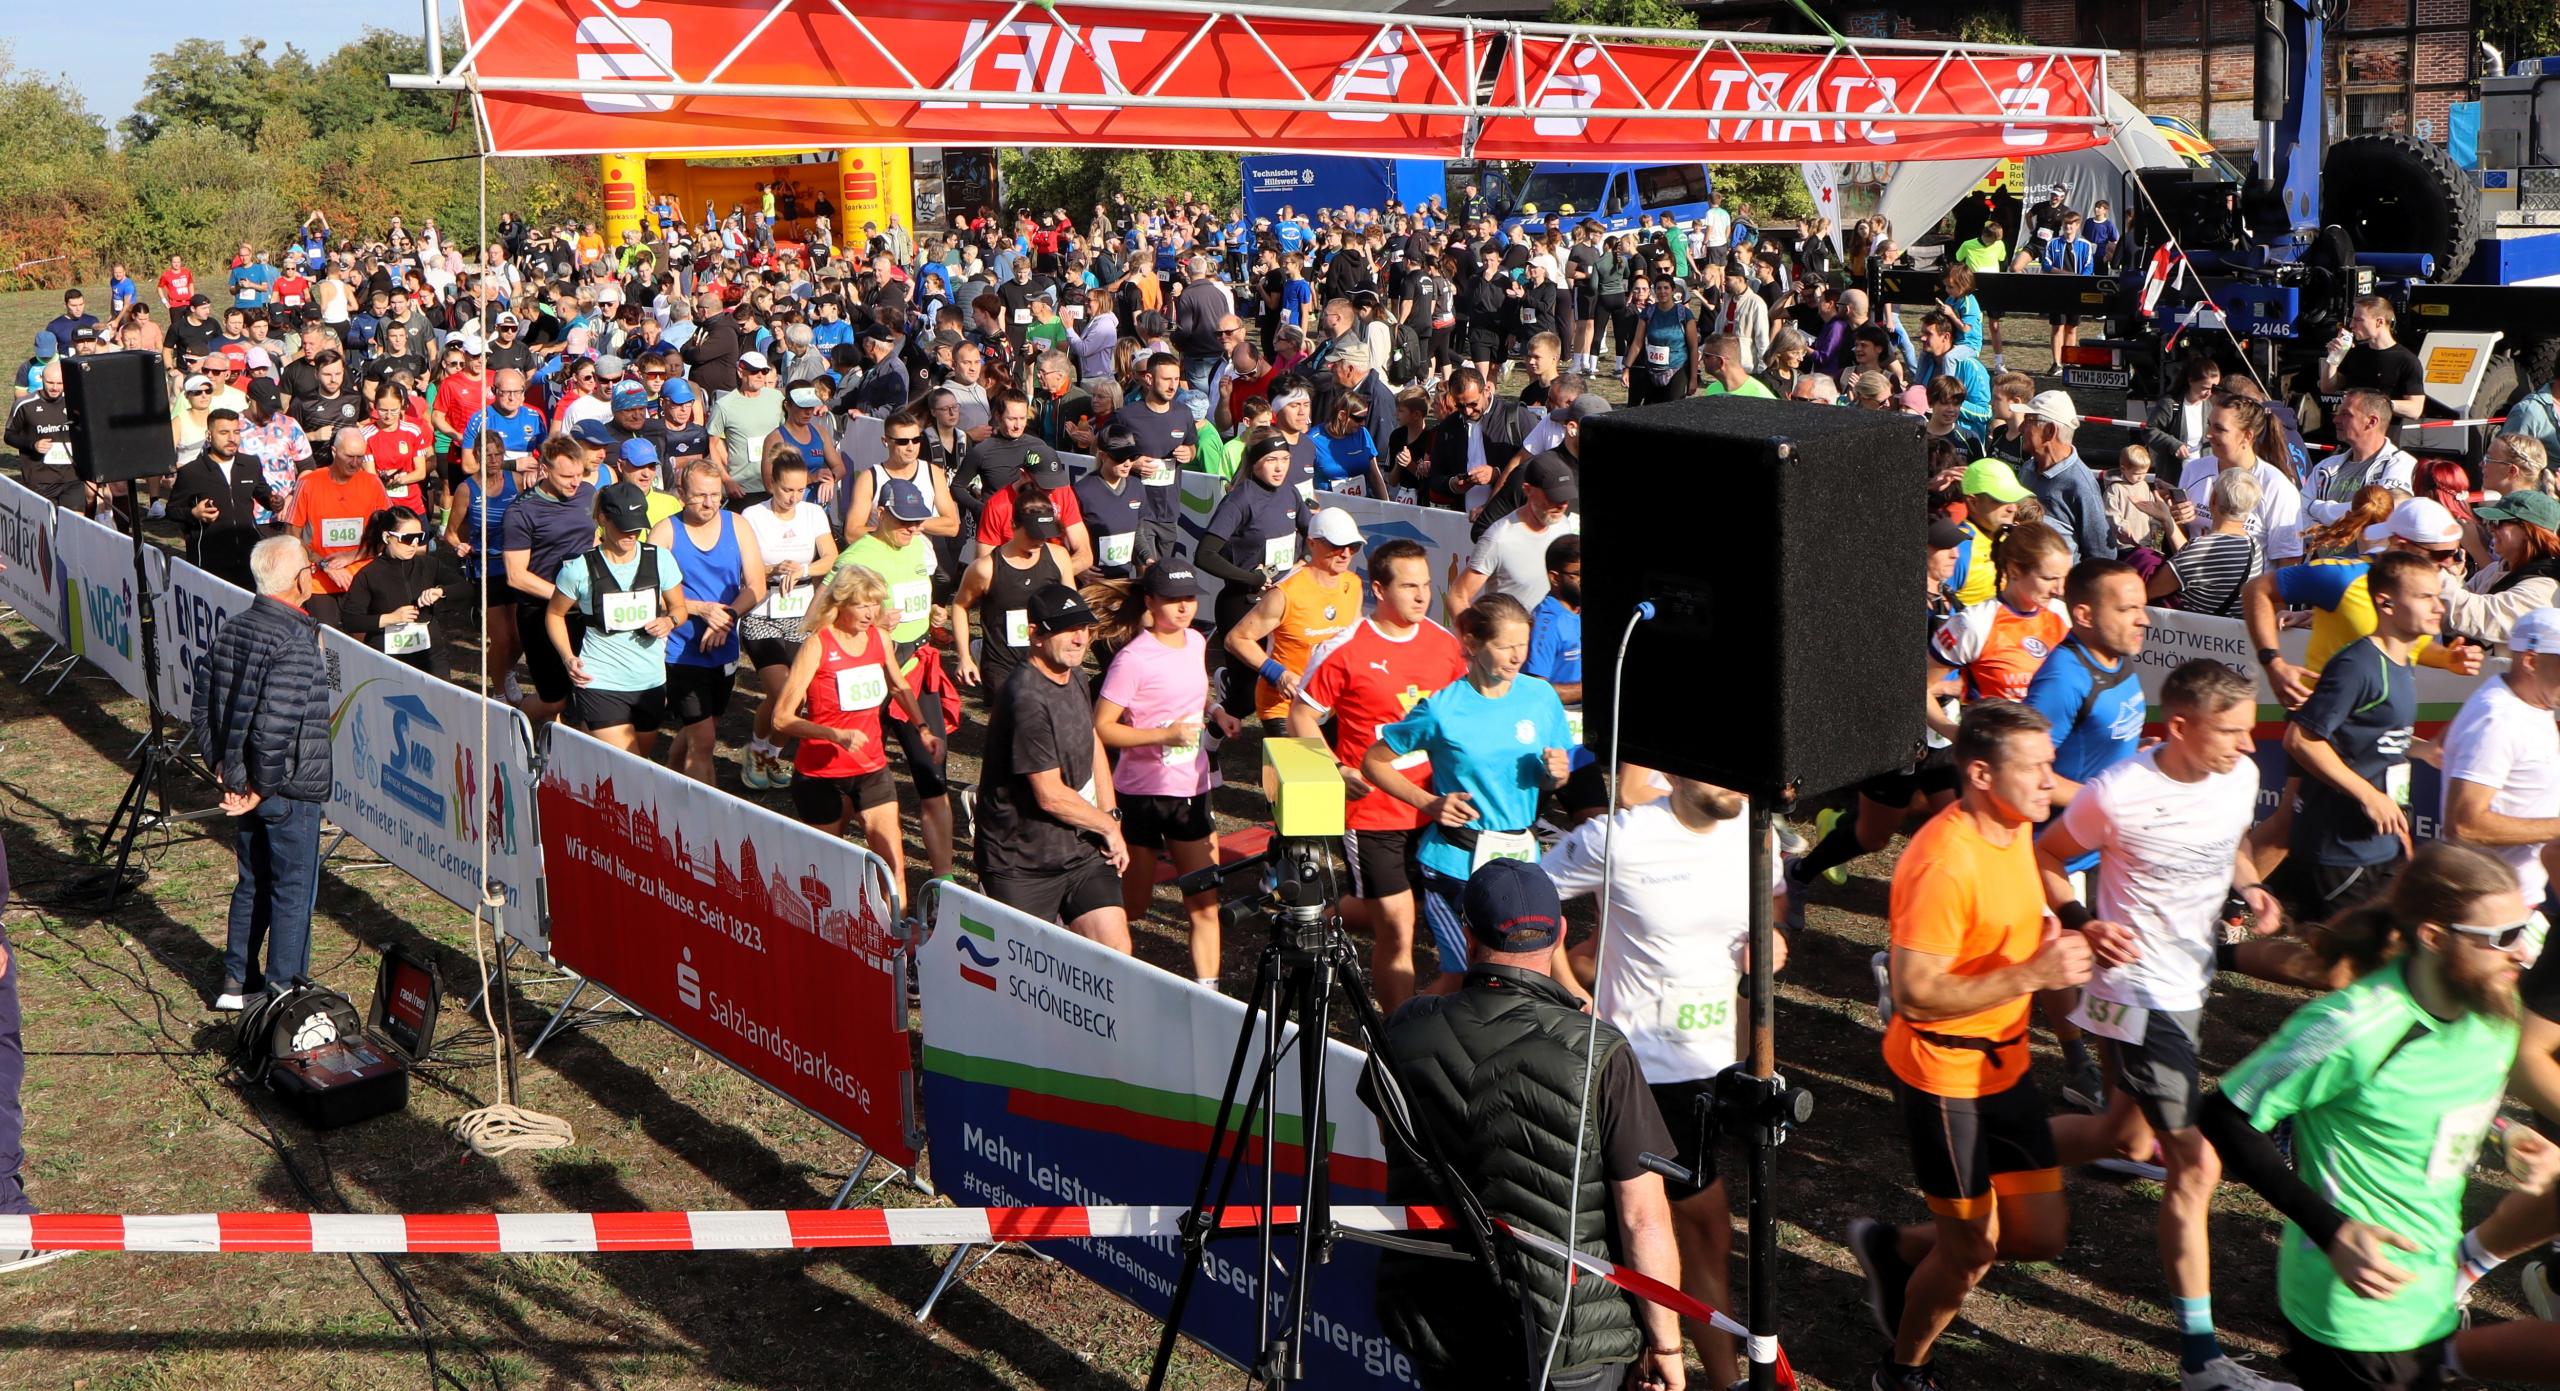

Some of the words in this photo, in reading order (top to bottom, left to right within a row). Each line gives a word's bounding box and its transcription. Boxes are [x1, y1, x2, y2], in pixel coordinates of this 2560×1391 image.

[1252, 169, 1298, 178] Technisches
[1264, 177, 1299, 185] Hilfswerk
[2252, 322, 2291, 336] 24/46
[1649, 351, 1665, 362] 246
[2071, 370, 2090, 383] THW
[2096, 372, 2127, 386] 89591
[330, 527, 357, 542] 948
[1107, 546, 1129, 561] 824
[613, 604, 648, 623] 906
[778, 596, 804, 612] 871
[84, 577, 129, 660] WBG
[393, 631, 422, 648] 921
[2144, 624, 2247, 656] TADTWERKE
[849, 679, 881, 703] 830
[335, 781, 351, 807] Der
[354, 791, 397, 837] Vemieter
[400, 819, 413, 849] für
[417, 832, 436, 863] alle
[564, 834, 588, 862] Wir
[591, 846, 613, 876] sind
[615, 855, 637, 888] hier
[639, 875, 655, 897] zu
[657, 877, 698, 920] Hause.
[699, 901, 727, 934] Seit
[728, 915, 767, 954] 1823.
[1007, 938, 1115, 1004] STADTWERKE
[1009, 974, 1118, 1043] SCHÖNEBECK
[1677, 1001, 1728, 1031] 835
[708, 991, 871, 1115] Salzlandsparkasse
[963, 1121, 1022, 1174] Mehr
[1303, 1310, 1421, 1390] nergie.
